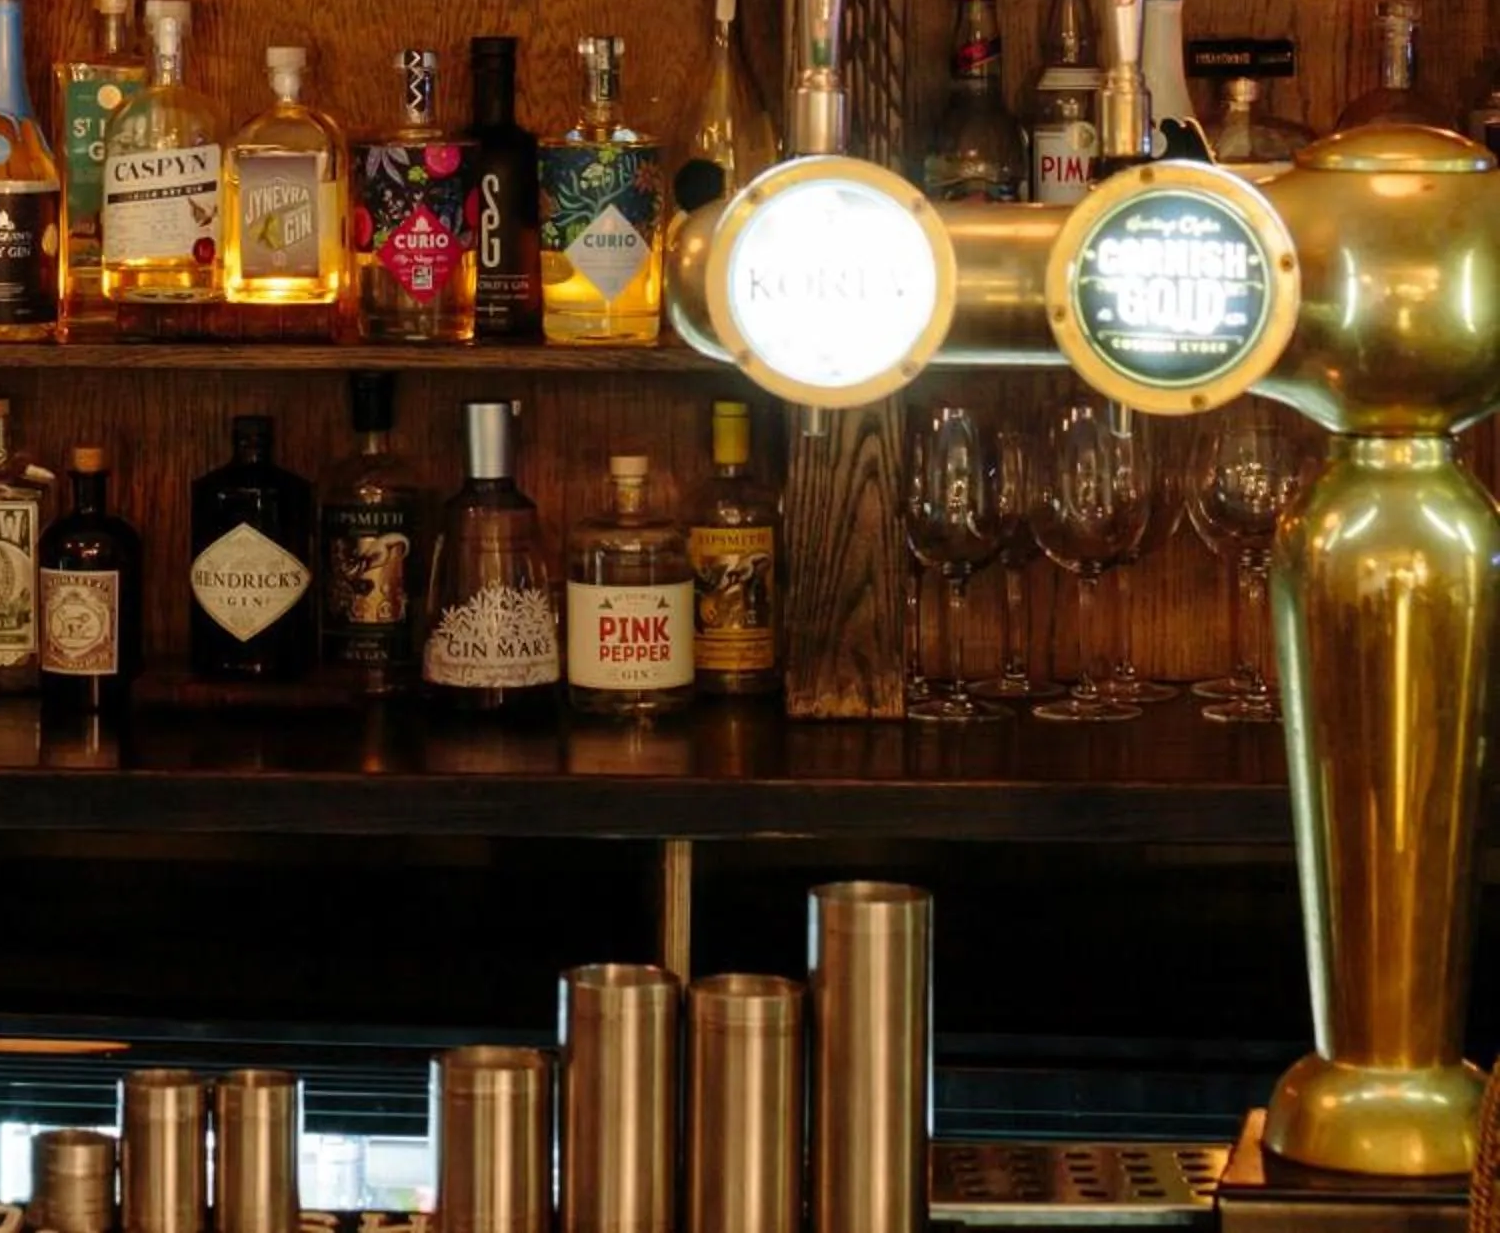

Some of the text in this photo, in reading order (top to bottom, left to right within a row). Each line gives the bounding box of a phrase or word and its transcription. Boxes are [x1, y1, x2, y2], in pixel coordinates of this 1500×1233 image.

[114, 151, 208, 183] CASPYN
[283, 210, 313, 246] GIN
[393, 233, 449, 250] CURIO
[583, 233, 639, 249] CURIO
[1096, 237, 1248, 279] CORNISH
[1115, 276, 1228, 335] GOLD
[194, 569, 302, 590] HENDRICK'S
[227, 597, 263, 608] GIN
[598, 615, 670, 644] PINK
[447, 639, 552, 659] GIN MARE
[598, 644, 671, 663] PEPPER
